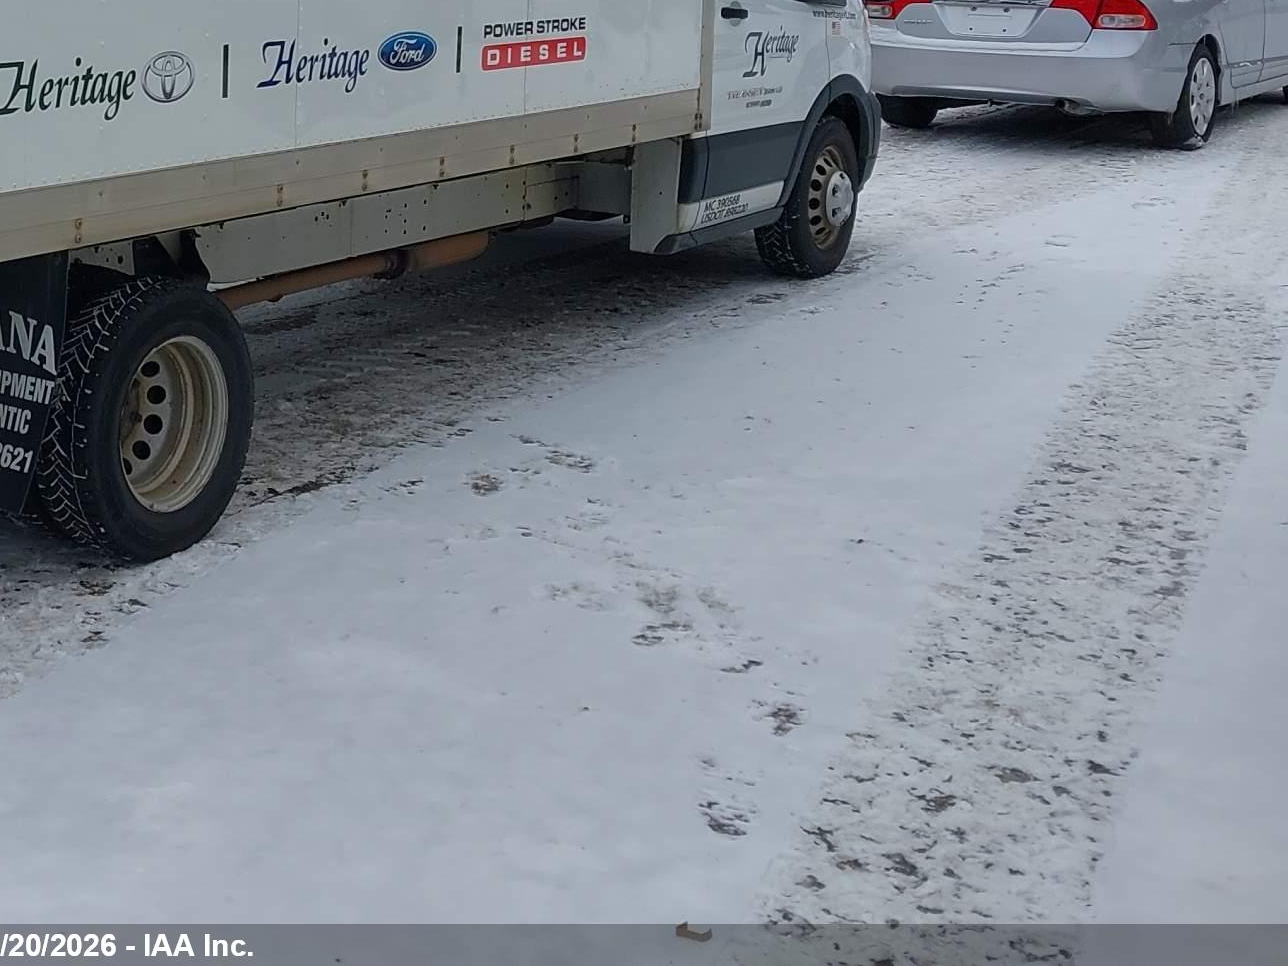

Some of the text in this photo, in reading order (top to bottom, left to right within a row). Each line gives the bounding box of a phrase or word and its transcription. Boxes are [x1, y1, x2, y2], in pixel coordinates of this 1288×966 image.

[483, 17, 587, 39] POWER STROKE
[486, 41, 584, 66] DIESEL
[742, 25, 800, 78] Heritage
[256, 37, 426, 94] Heritage Ford
[703, 199, 717, 212] MC
